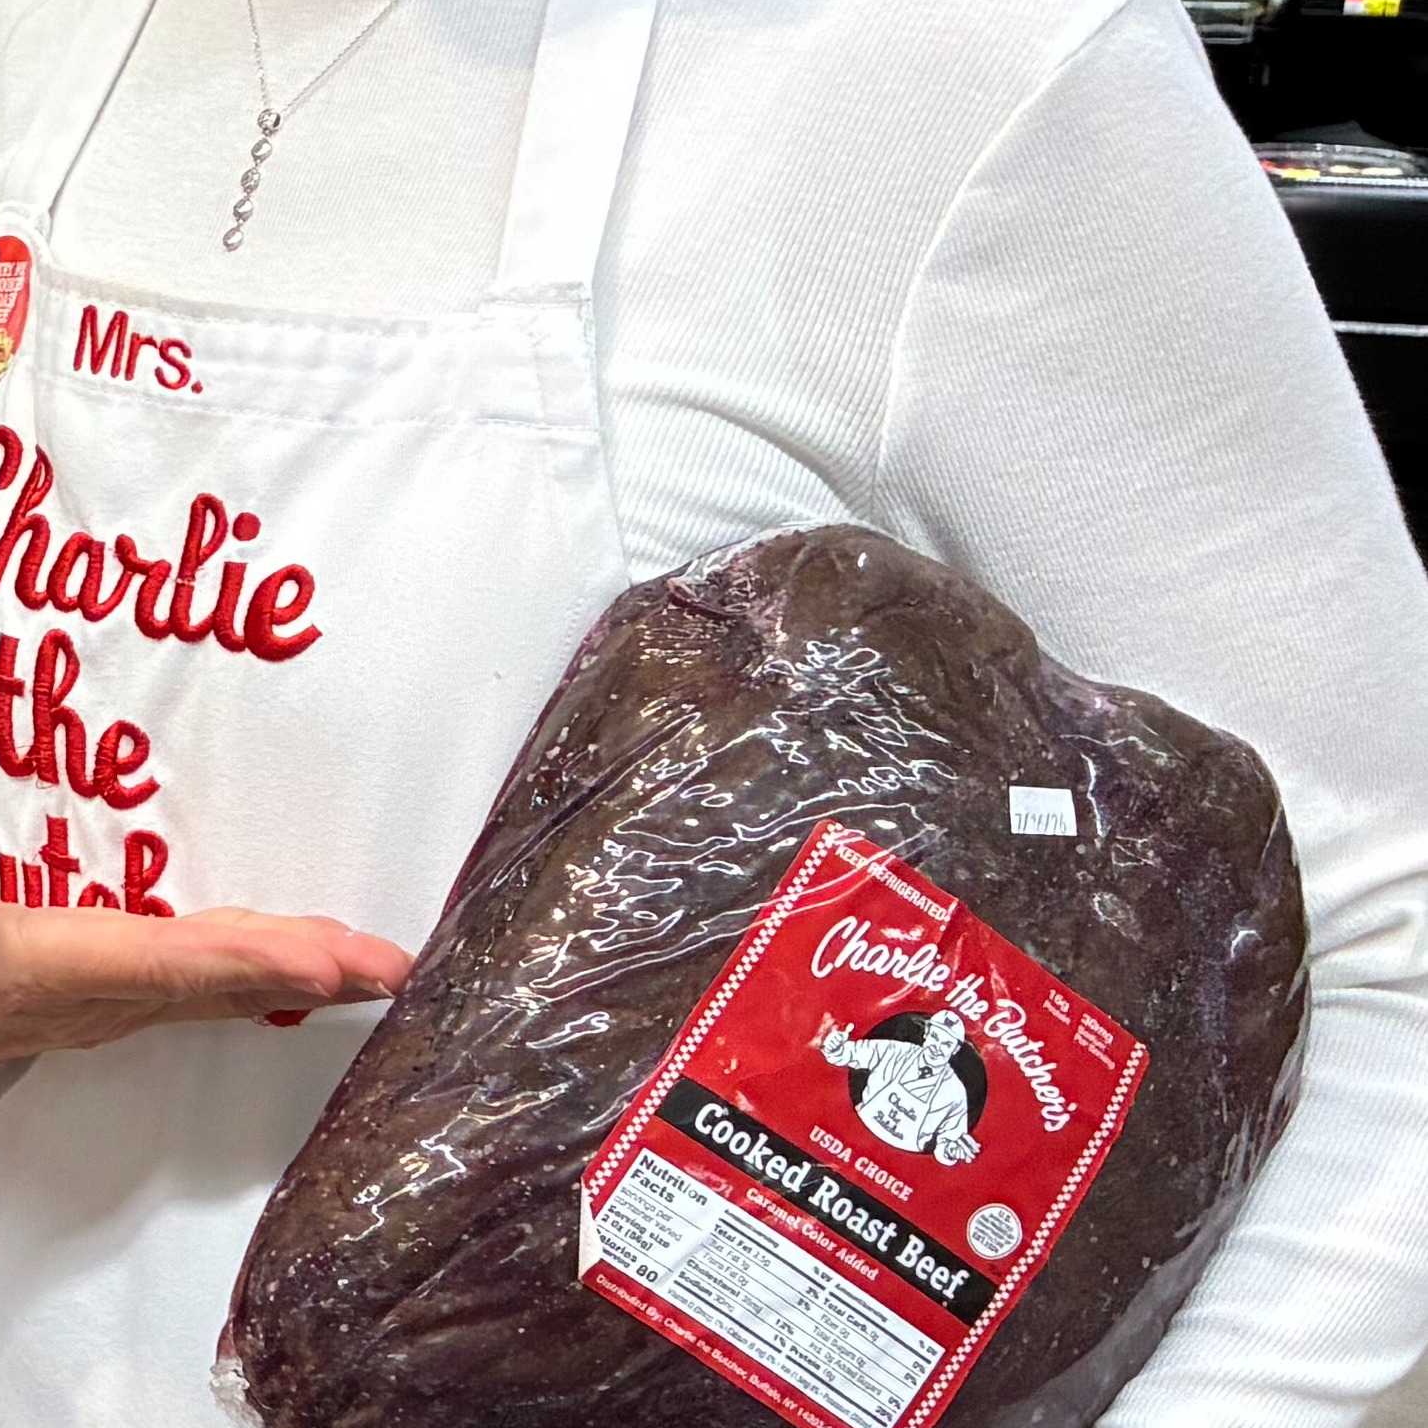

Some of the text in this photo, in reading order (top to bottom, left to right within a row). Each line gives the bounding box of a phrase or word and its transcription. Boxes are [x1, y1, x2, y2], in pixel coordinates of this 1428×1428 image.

[73, 303, 204, 395] Mrs.
[867, 862, 948, 922] REFRIGERATED
[811, 915, 951, 992] Charlie
[945, 973, 989, 1021] the
[984, 998, 1078, 1132] Butcher's
[629, 1169, 675, 1204] Facts
[637, 1154, 708, 1207] Nutrition
[694, 1102, 812, 1193] Cooked
[808, 1176, 897, 1253] Roast
[895, 1233, 970, 1300] Beef
[809, 1125, 913, 1201] USDA CHOICE
[746, 1187, 879, 1281] Caramel Color Added
